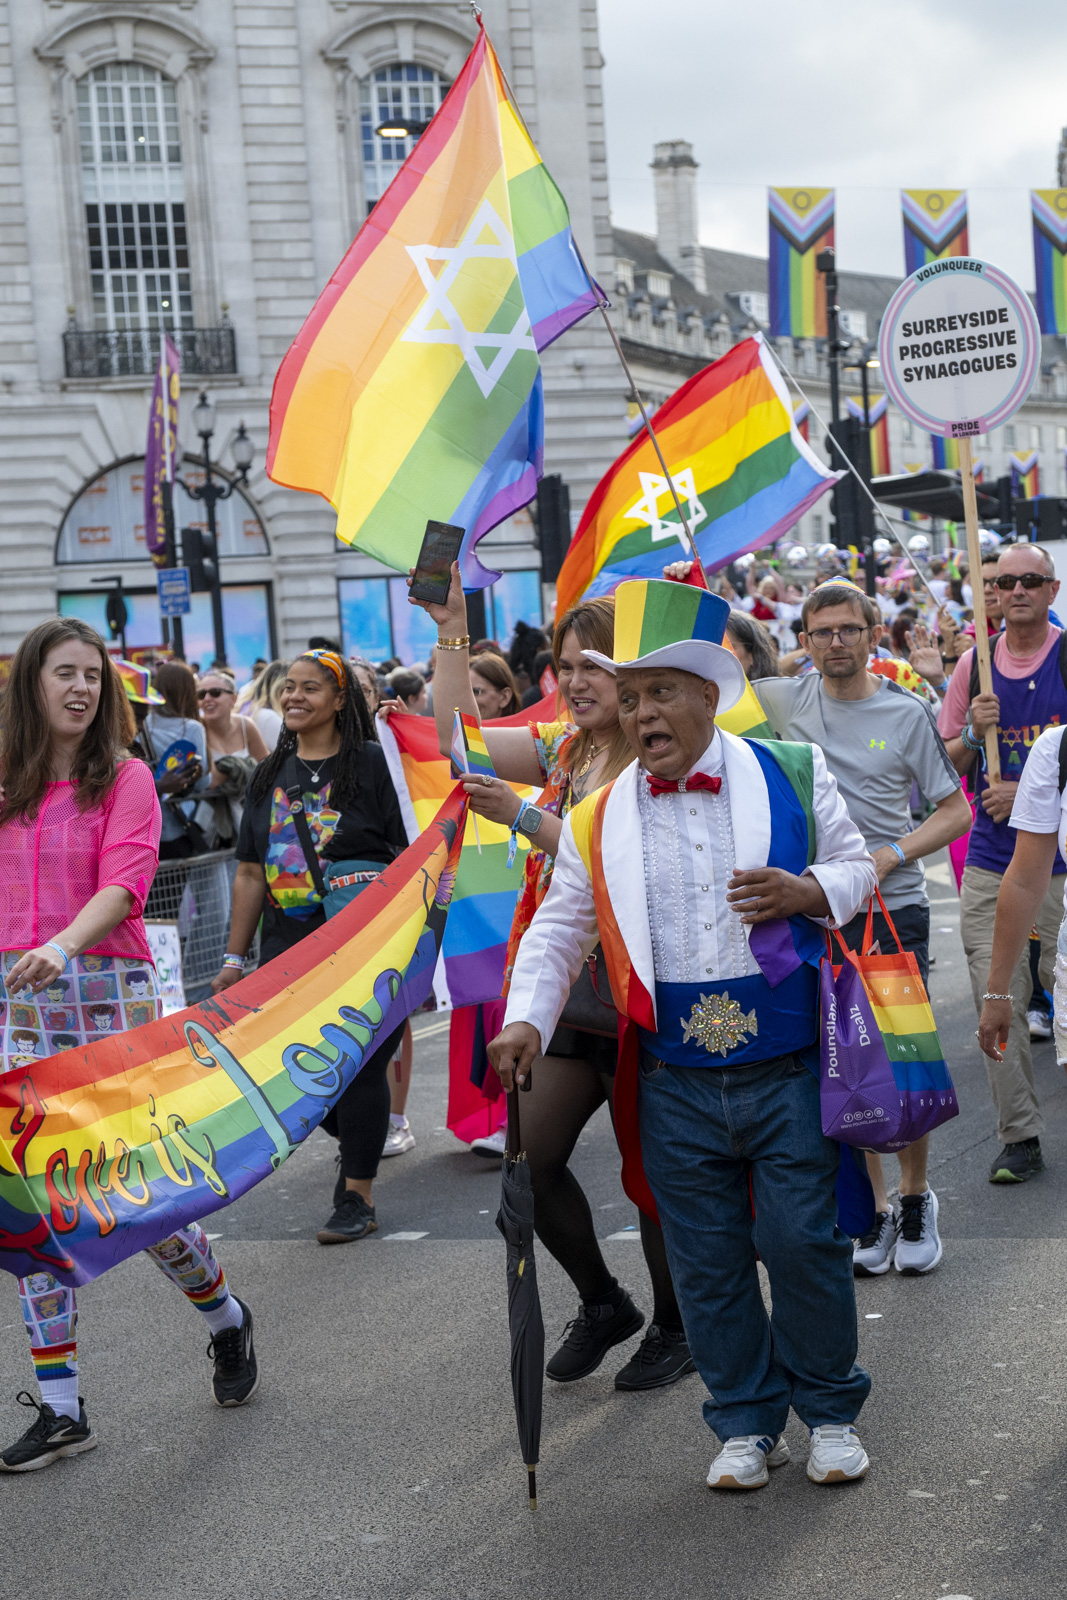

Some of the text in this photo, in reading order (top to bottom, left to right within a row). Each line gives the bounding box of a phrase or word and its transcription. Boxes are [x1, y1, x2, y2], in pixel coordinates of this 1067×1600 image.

[916, 260, 983, 282] VOLUNQUEER
[902, 307, 1009, 337] SURREYSIDE
[899, 329, 1017, 361] PROGRESSIVE
[903, 353, 1017, 382] SYNAGOGUES
[827, 992, 840, 1078] Poundland
[849, 1003, 871, 1047] Dealz
[148, 1093, 231, 1199] is
